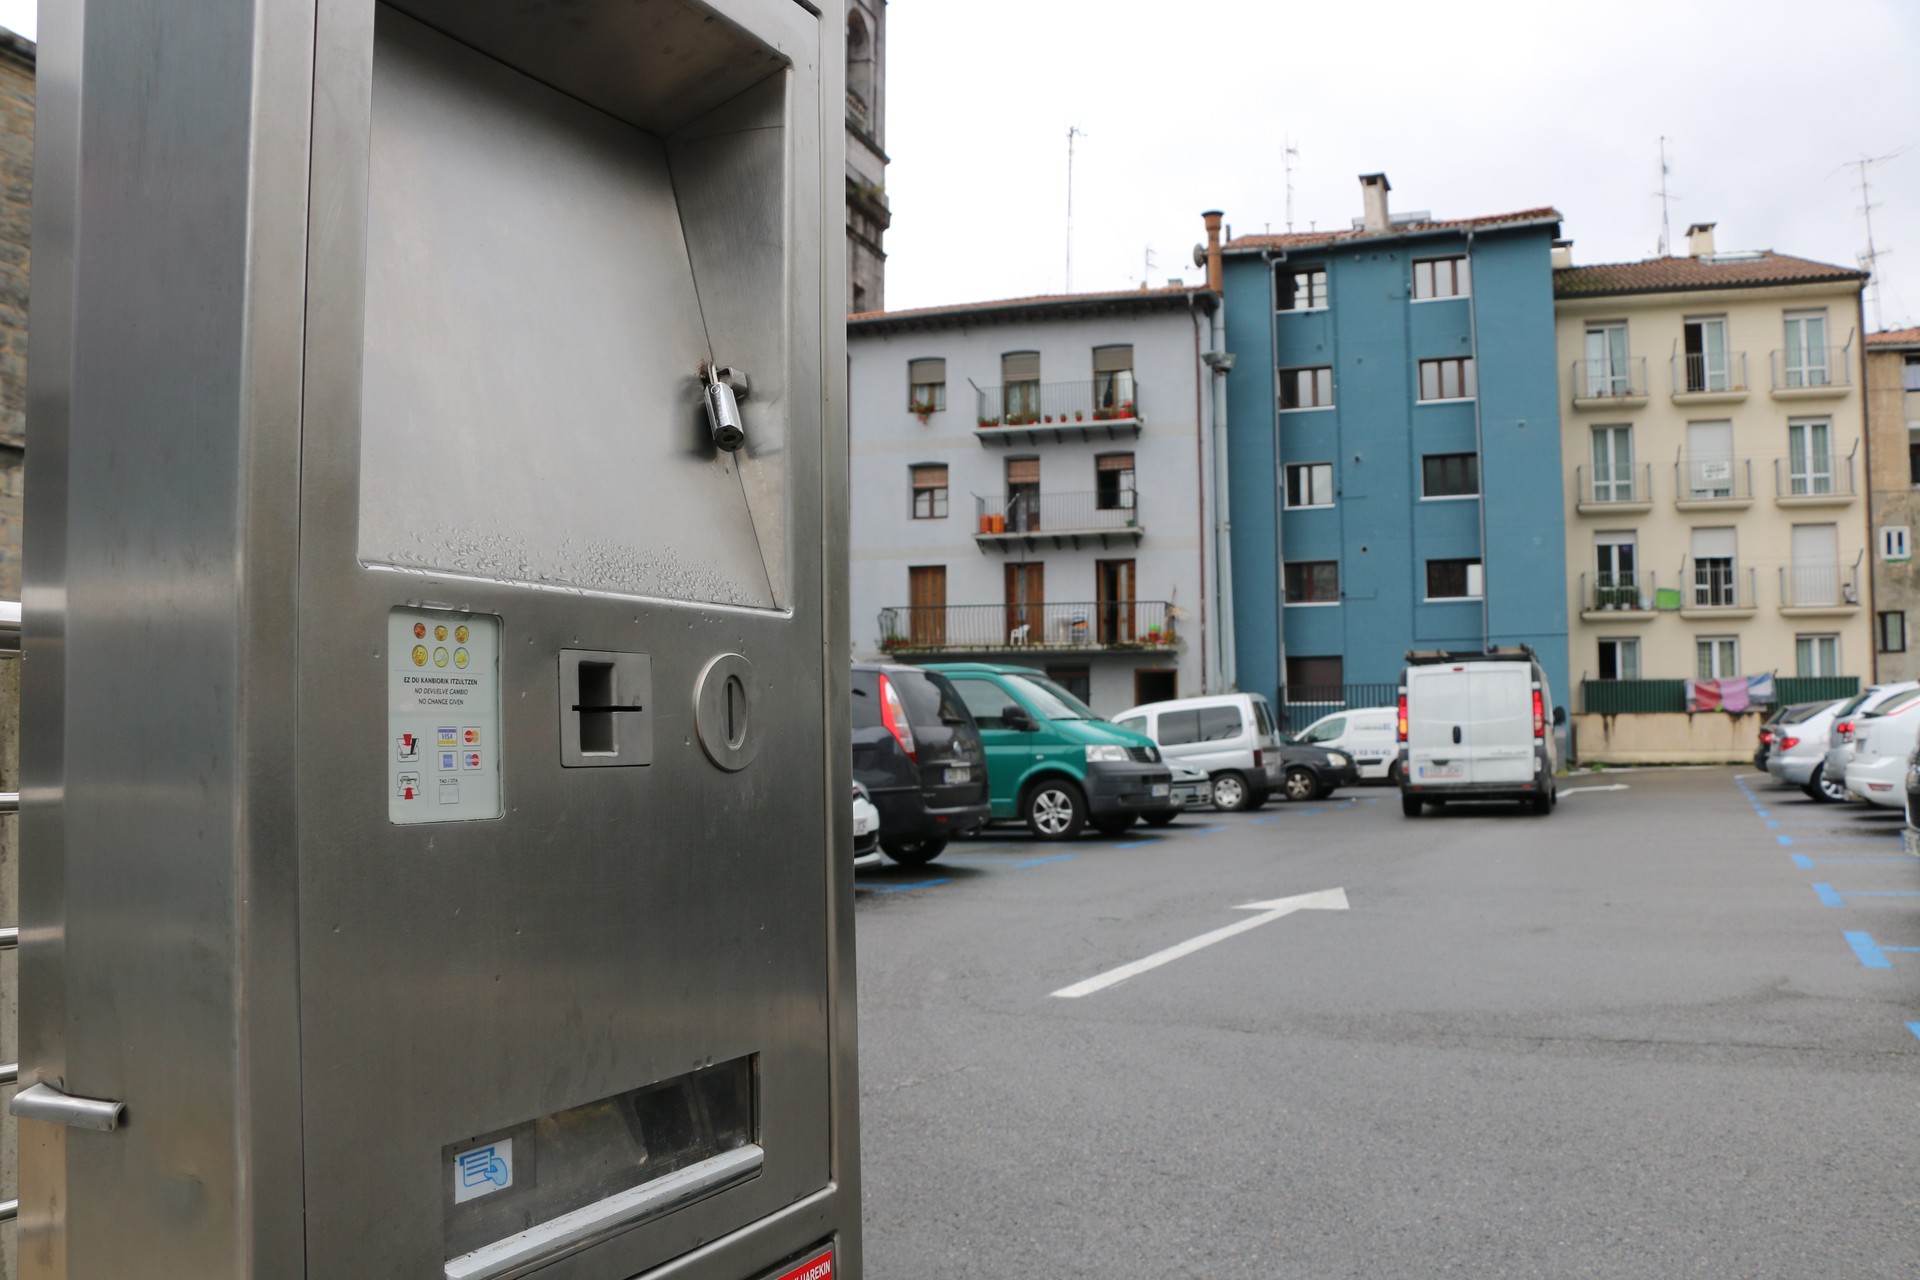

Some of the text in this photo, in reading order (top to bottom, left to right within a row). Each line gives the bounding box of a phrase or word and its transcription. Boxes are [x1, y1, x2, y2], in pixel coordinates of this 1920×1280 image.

[403, 676, 478, 686] EZ DU KANBIORIK ITZULTZEN
[423, 687, 449, 695] DEVUELVE
[449, 688, 469, 696] CAMBIO
[427, 698, 448, 706] CHANGE
[448, 698, 464, 706] GIVEN
